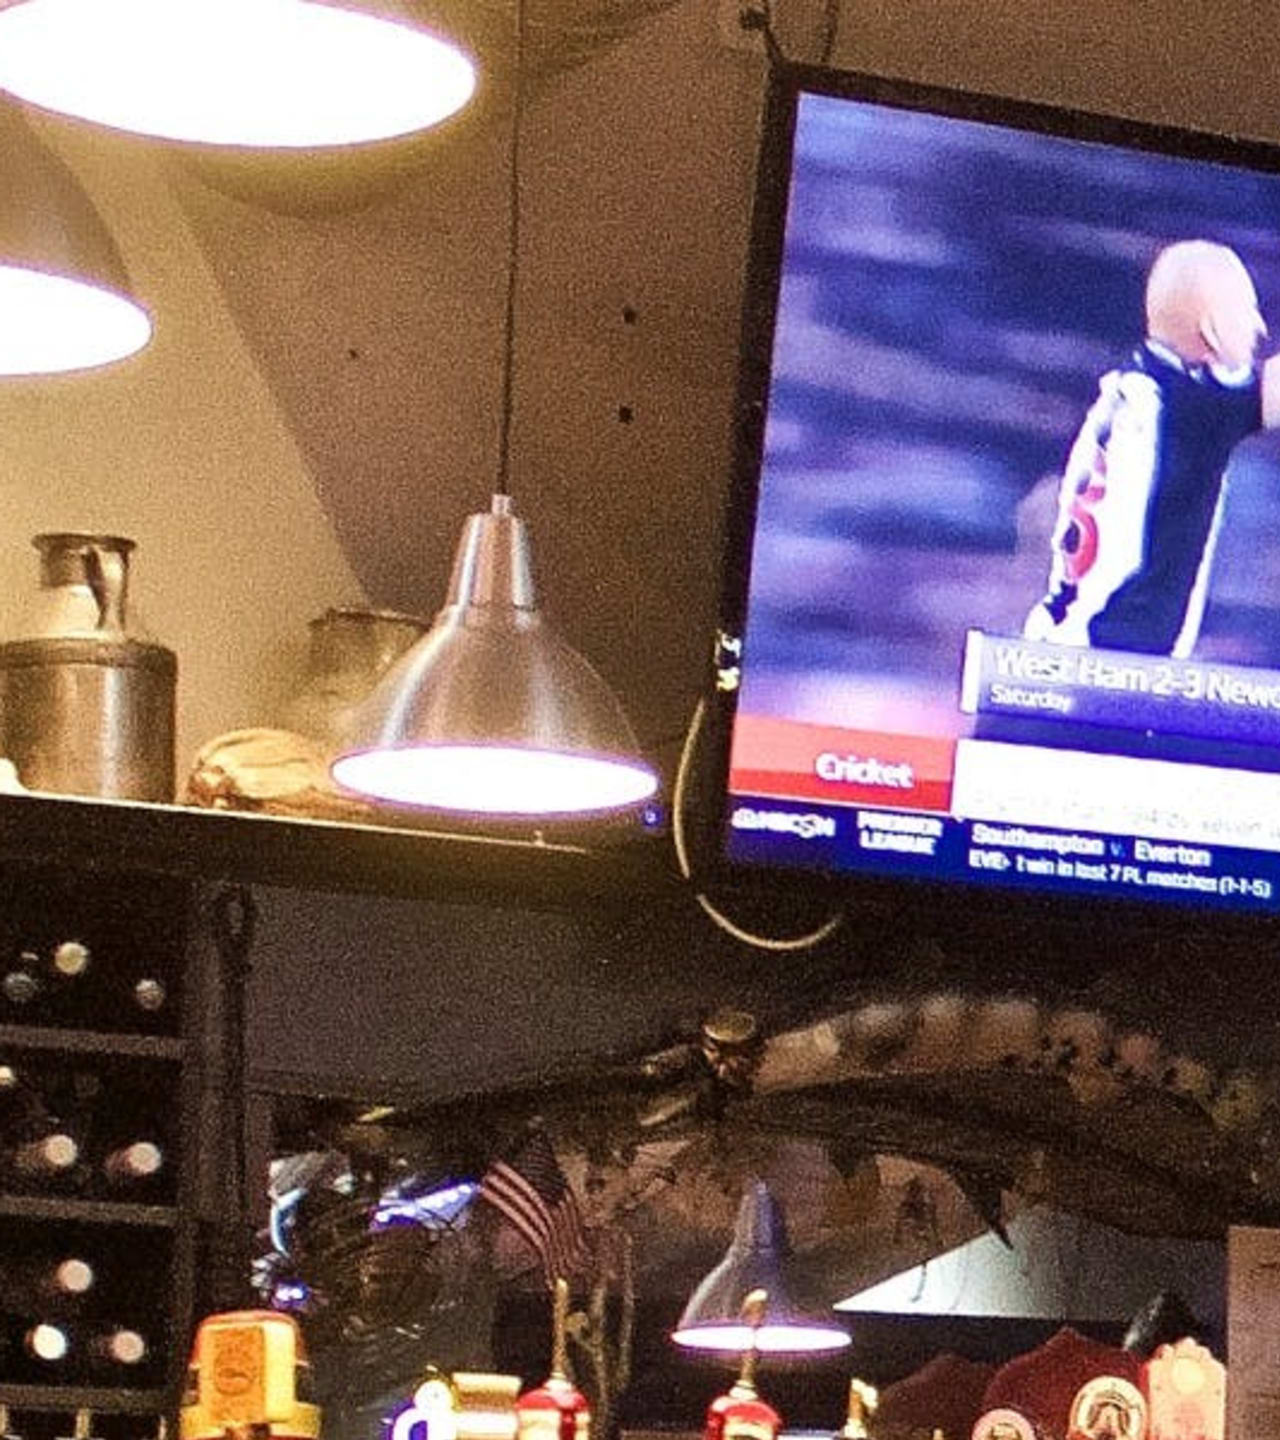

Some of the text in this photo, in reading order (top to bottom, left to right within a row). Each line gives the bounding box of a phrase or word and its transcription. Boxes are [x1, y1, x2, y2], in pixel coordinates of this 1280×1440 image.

[996, 648, 1074, 684] West
[1078, 656, 1147, 692] Ham
[814, 752, 914, 788] Cricket
[1134, 838, 1211, 867] Everton
